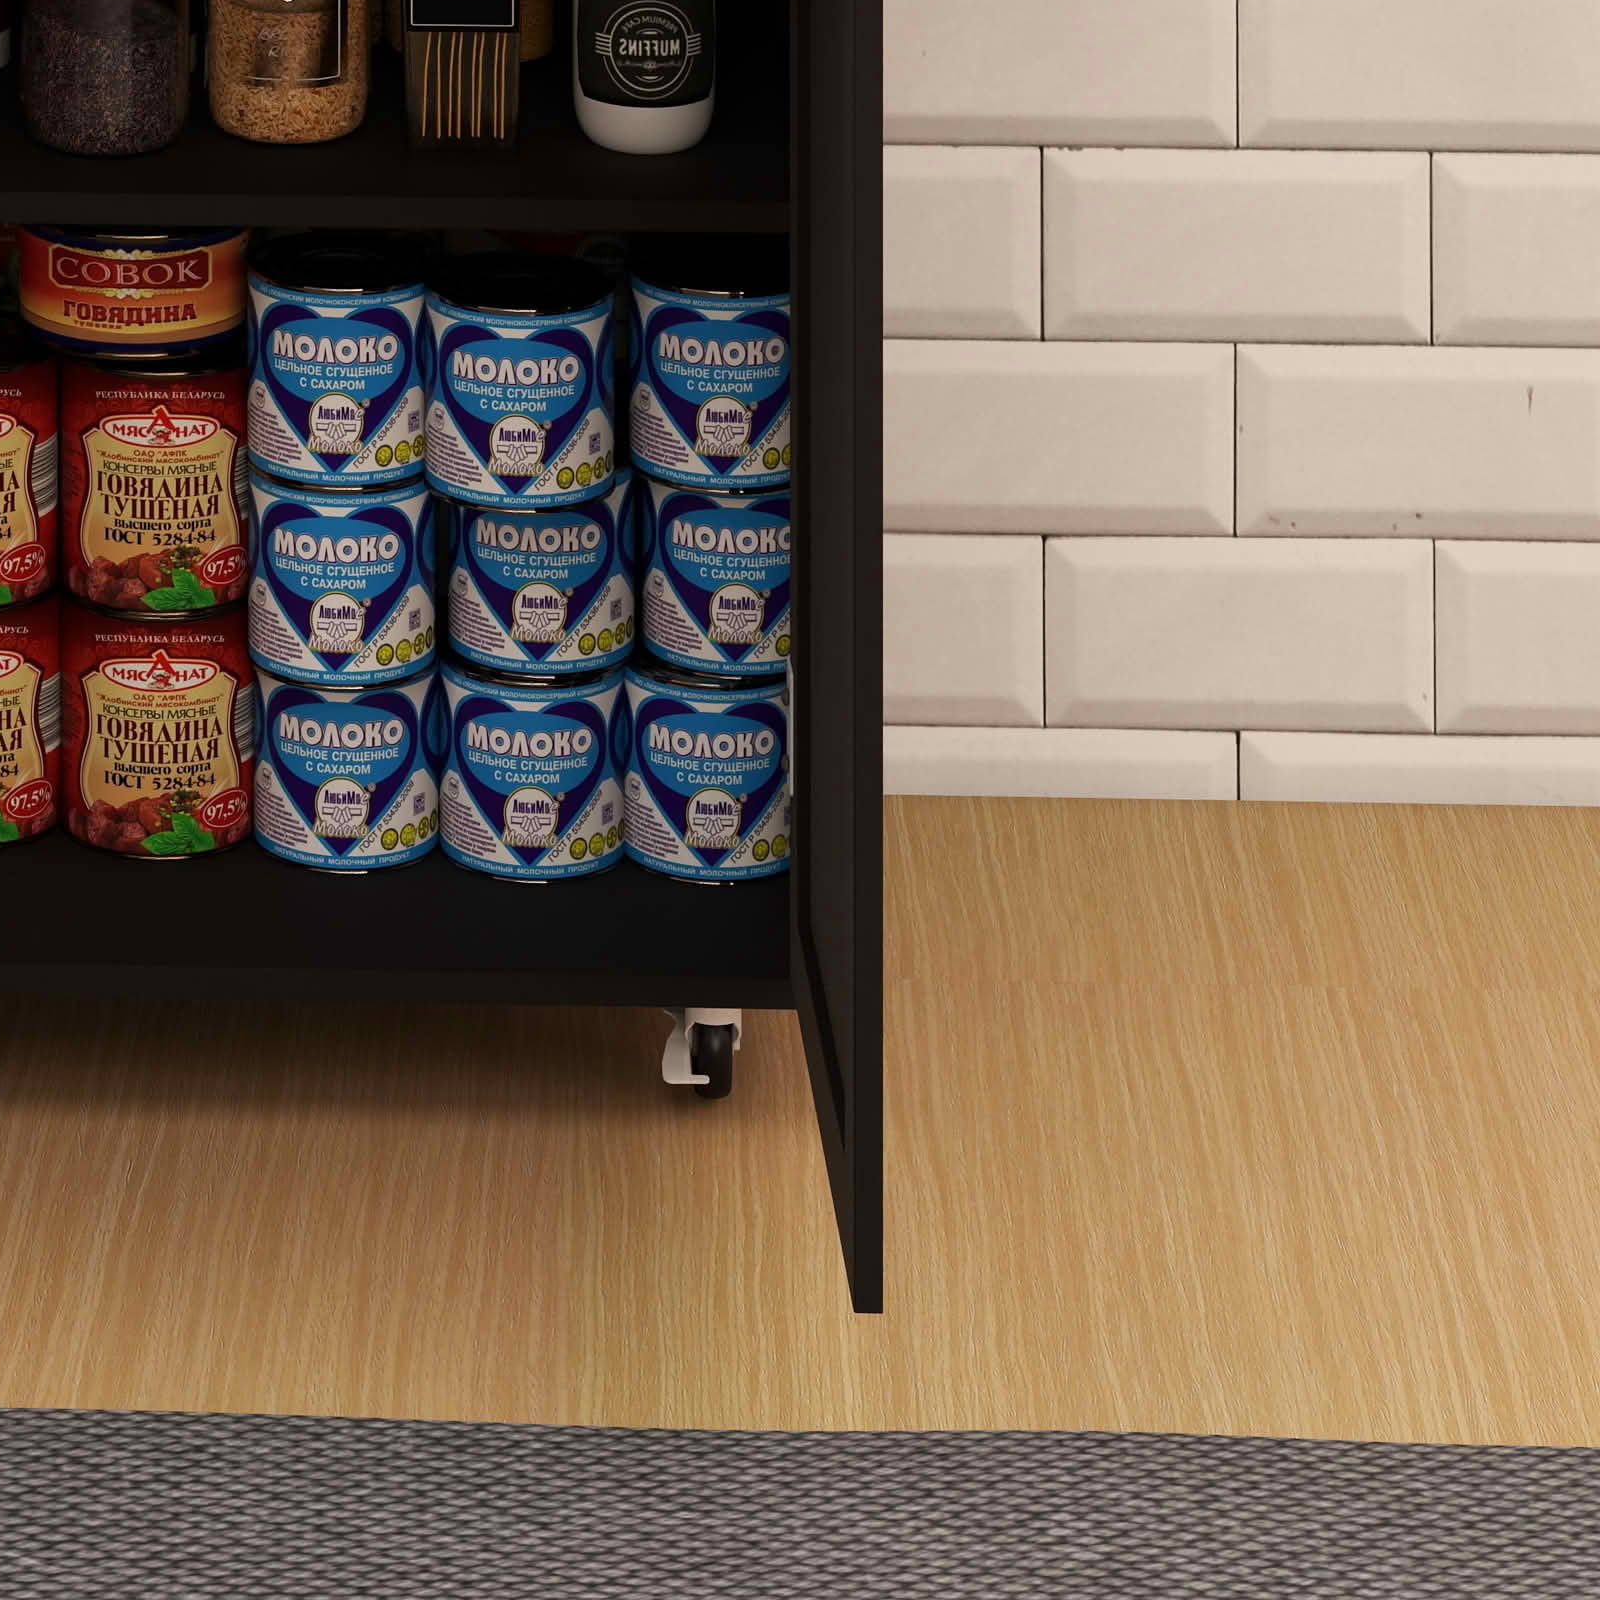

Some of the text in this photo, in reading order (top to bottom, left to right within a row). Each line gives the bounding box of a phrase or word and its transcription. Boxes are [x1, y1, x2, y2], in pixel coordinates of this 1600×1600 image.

[55, 256, 203, 286] СОВОК
[63, 300, 198, 326] ГОВЯДИНА
[273, 329, 398, 364] МОЛОКО
[660, 332, 786, 367] МОЛОКО
[275, 359, 392, 378] ЦЕЛЬНОЕ СГУЩЕННОЕ
[453, 350, 579, 385] МОЛОКО
[662, 362, 780, 381] ЦЕЛЬНОЕ СГУЩЕННОЕ
[300, 377, 365, 390] С САХАРОМ
[455, 380, 574, 399] ЦЕЛЬНОЕ СГУЩЕННОЕ
[687, 380, 752, 393] С САХАРОМ
[480, 399, 546, 411] С САХАРОМ
[98, 470, 223, 501] ГОВЯДИНА
[103, 493, 219, 520] ТУШЕНАЯ
[106, 527, 215, 546] ГОСТ 5284-84
[274, 528, 399, 563] МОЛОКО
[476, 519, 601, 553] МОЛОКО
[4, 550, 45, 575] 97,5%
[478, 549, 596, 567] ЦЕЛЬНОЕ СГУЩЕННОЕ
[675, 549, 722, 566] ЦЕЛЬНОЕ
[276, 558, 393, 577] ЦЕЛЬНОЕ СГУЩЕННОЕ
[503, 567, 568, 579] С САХАРОМ
[700, 567, 765, 580] С САХАРОМ
[301, 576, 366, 589] С САХАРОМ
[98, 714, 223, 745] ГОВЯДИНА
[279, 713, 403, 749] МОЛОКО
[468, 722, 592, 758] МОЛОКО
[650, 723, 775, 759] МОЛОКО
[102, 737, 219, 764] ТУШЕНАЯ
[281, 743, 398, 762] ЦЕЛЬНОЕ СГУЩЕННОЕ
[306, 761, 370, 774] С САХАРОМ
[469, 752, 587, 771] ЦЕЛЬНОЕ СГУЩЕННОЕ
[652, 753, 769, 773] ЦЕЛЬНОЕ СГУЩЕННОЕ
[105, 771, 215, 790] ГОСТ 5284-84
[494, 770, 559, 783] С САХАРОМ
[677, 772, 742, 785] С САХАРОМ
[11, 787, 52, 812] 97,5%
